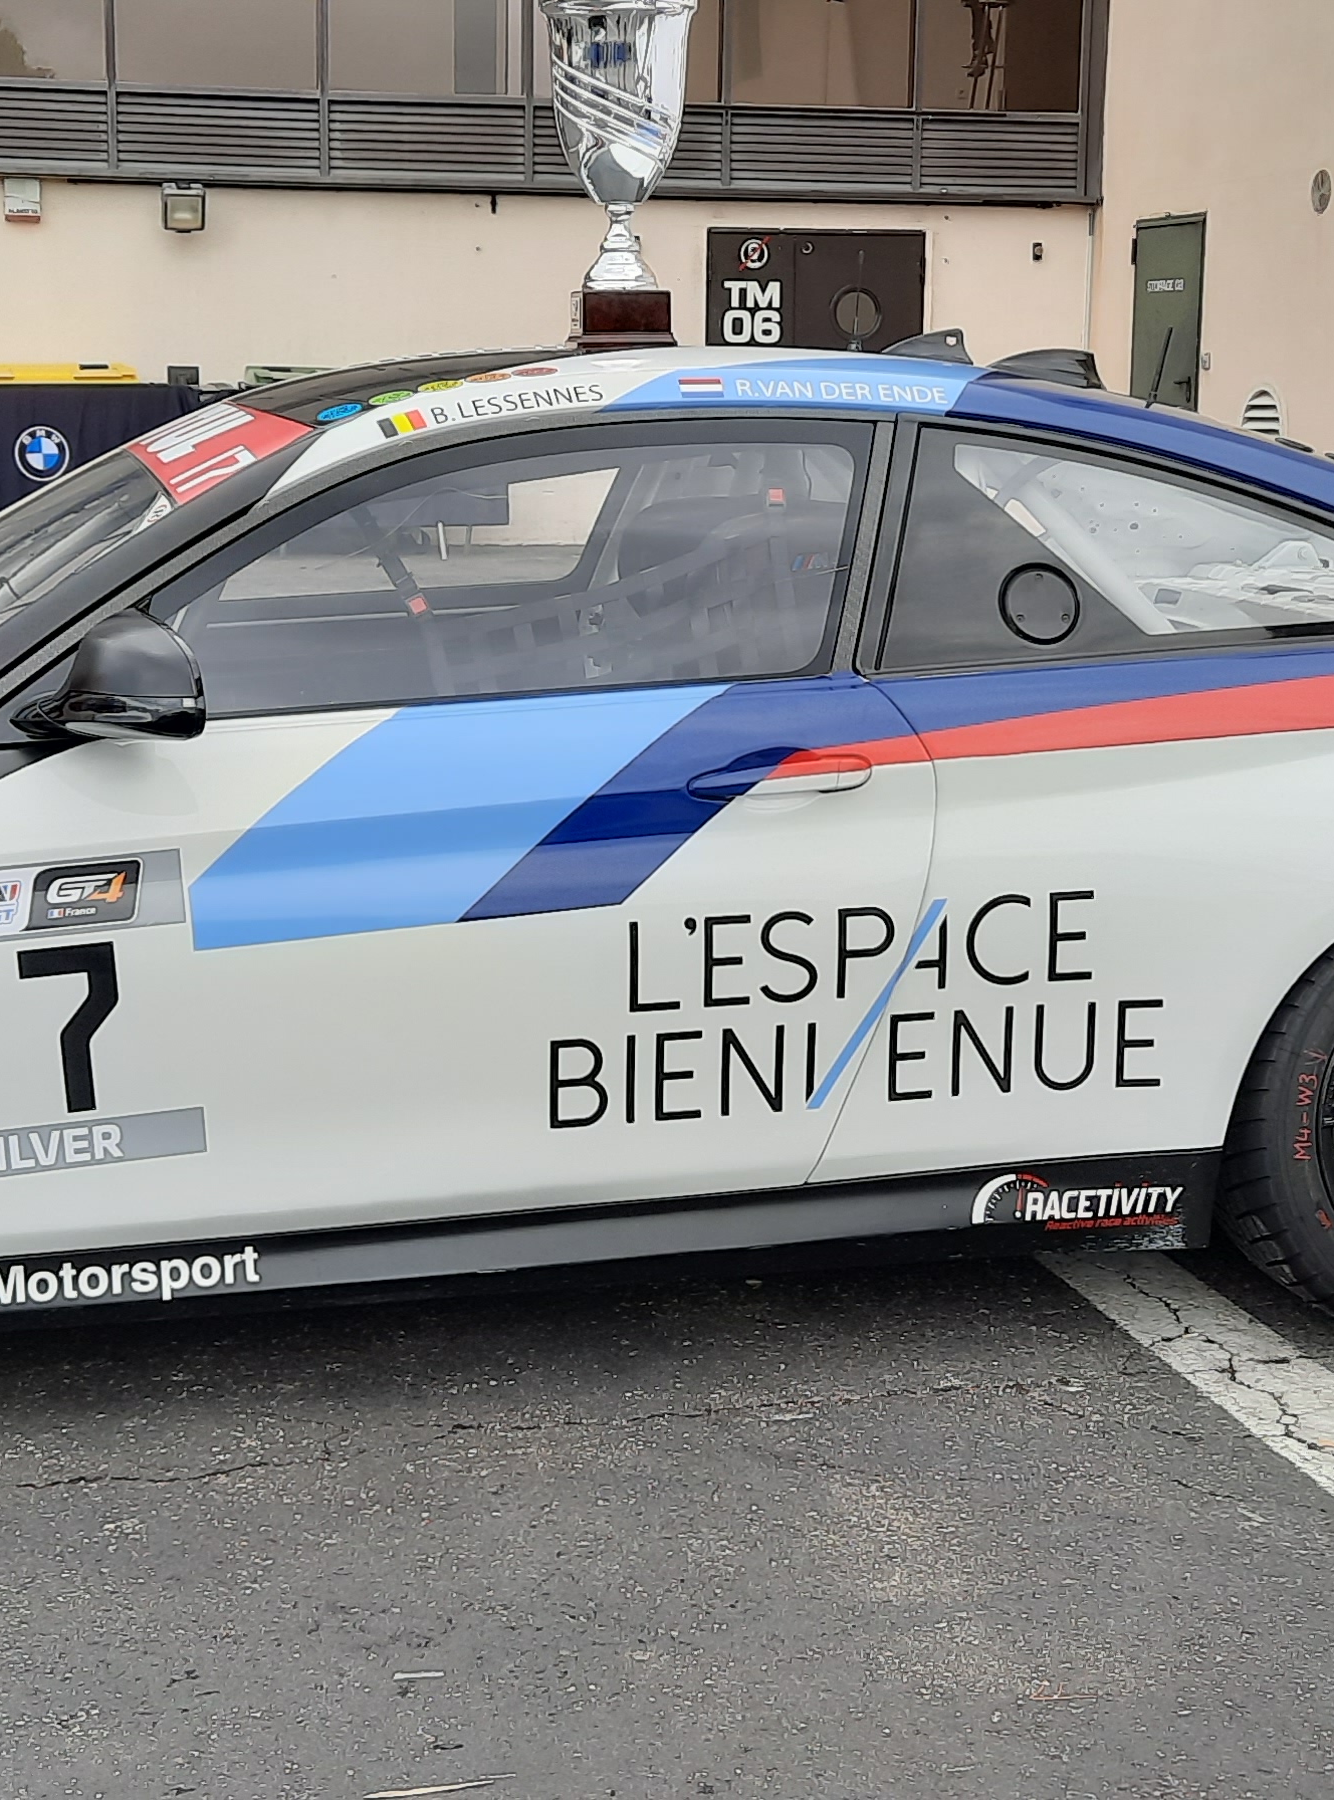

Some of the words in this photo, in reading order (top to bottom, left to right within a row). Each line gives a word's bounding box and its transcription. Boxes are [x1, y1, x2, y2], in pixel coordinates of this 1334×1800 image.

[723, 280, 781, 308] TM
[723, 309, 781, 344] 06
[820, 382, 873, 400] DER
[877, 384, 949, 404] ENDE
[169, 445, 258, 494] 17
[46, 871, 126, 904] GT4
[65, 906, 97, 917] France
[628, 889, 1095, 1014] L'ESPACE
[549, 998, 1165, 1129] BIENVENUE
[1045, 1219, 1093, 1231] Reactive
[1095, 1218, 1122, 1228] race
